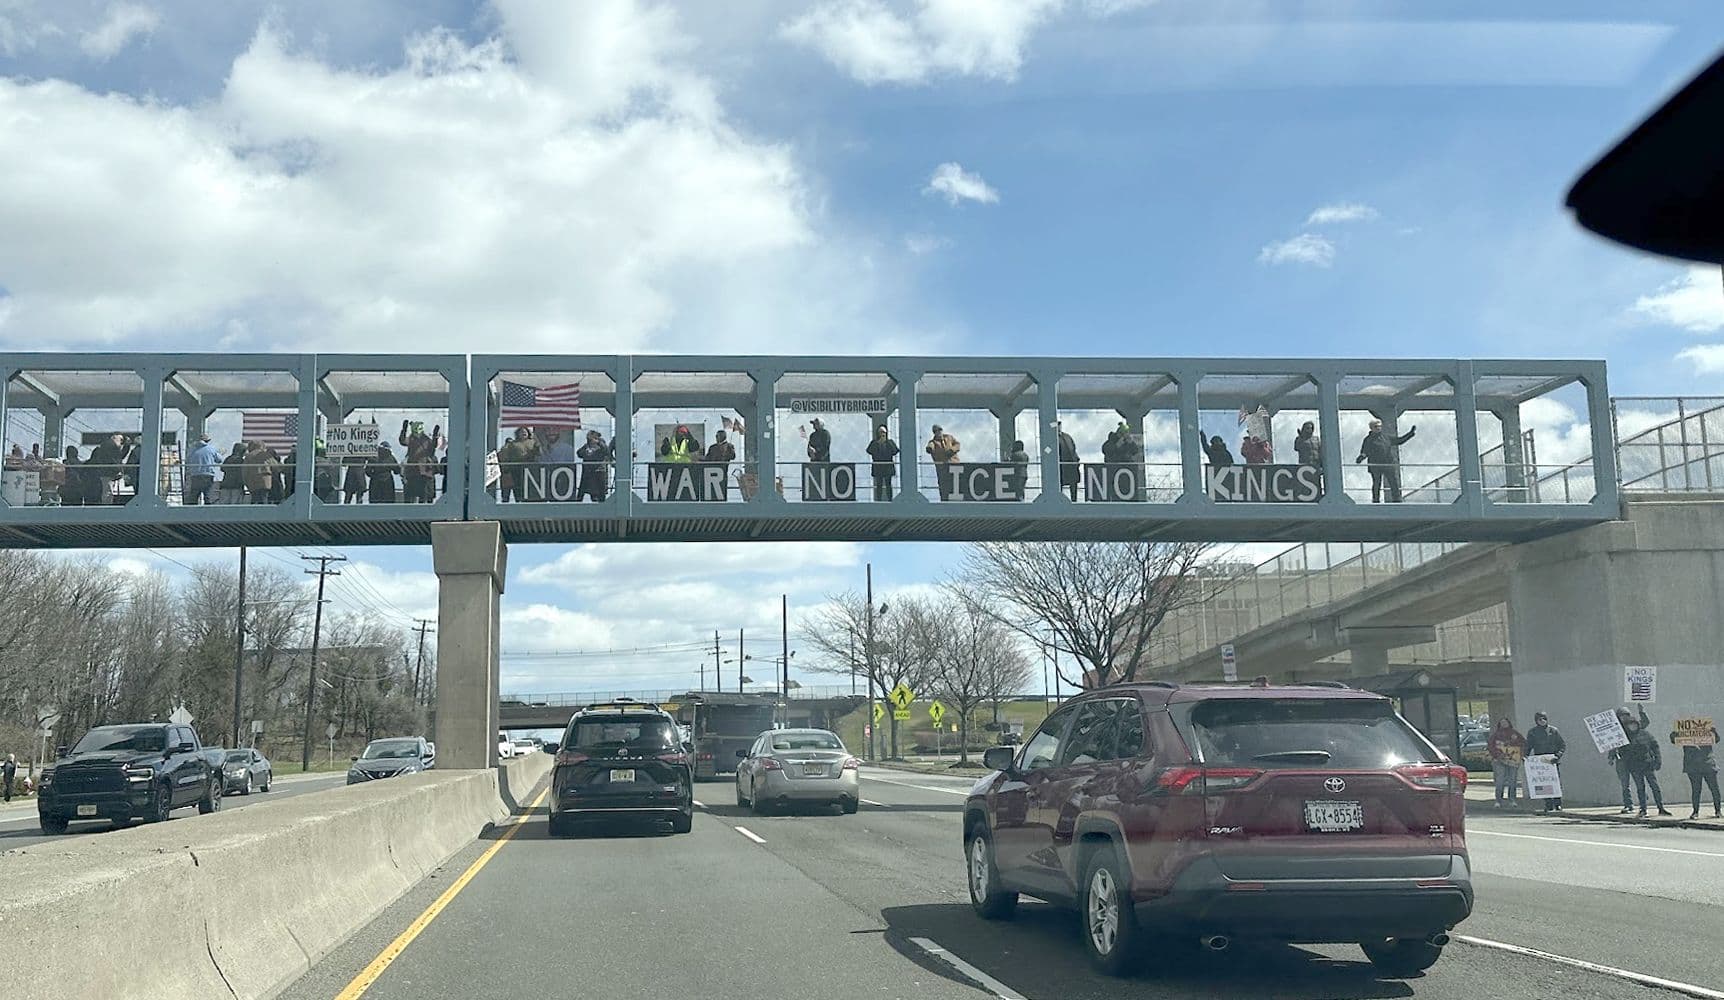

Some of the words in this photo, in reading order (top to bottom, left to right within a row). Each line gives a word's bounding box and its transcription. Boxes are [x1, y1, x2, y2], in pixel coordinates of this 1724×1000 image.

[792, 400, 885, 412] @VISIBILITYBRIGADE
[327, 428, 346, 440] #No
[350, 428, 379, 443] Kings
[326, 443, 345, 452] from
[348, 442, 378, 454] Queens
[524, 467, 574, 500] NO
[650, 467, 725, 500] WAR
[805, 465, 853, 499] NO
[948, 465, 1016, 500] ICE
[1087, 467, 1135, 500] NO
[1207, 465, 1318, 501] KINGS
[1677, 720, 1691, 729] NO
